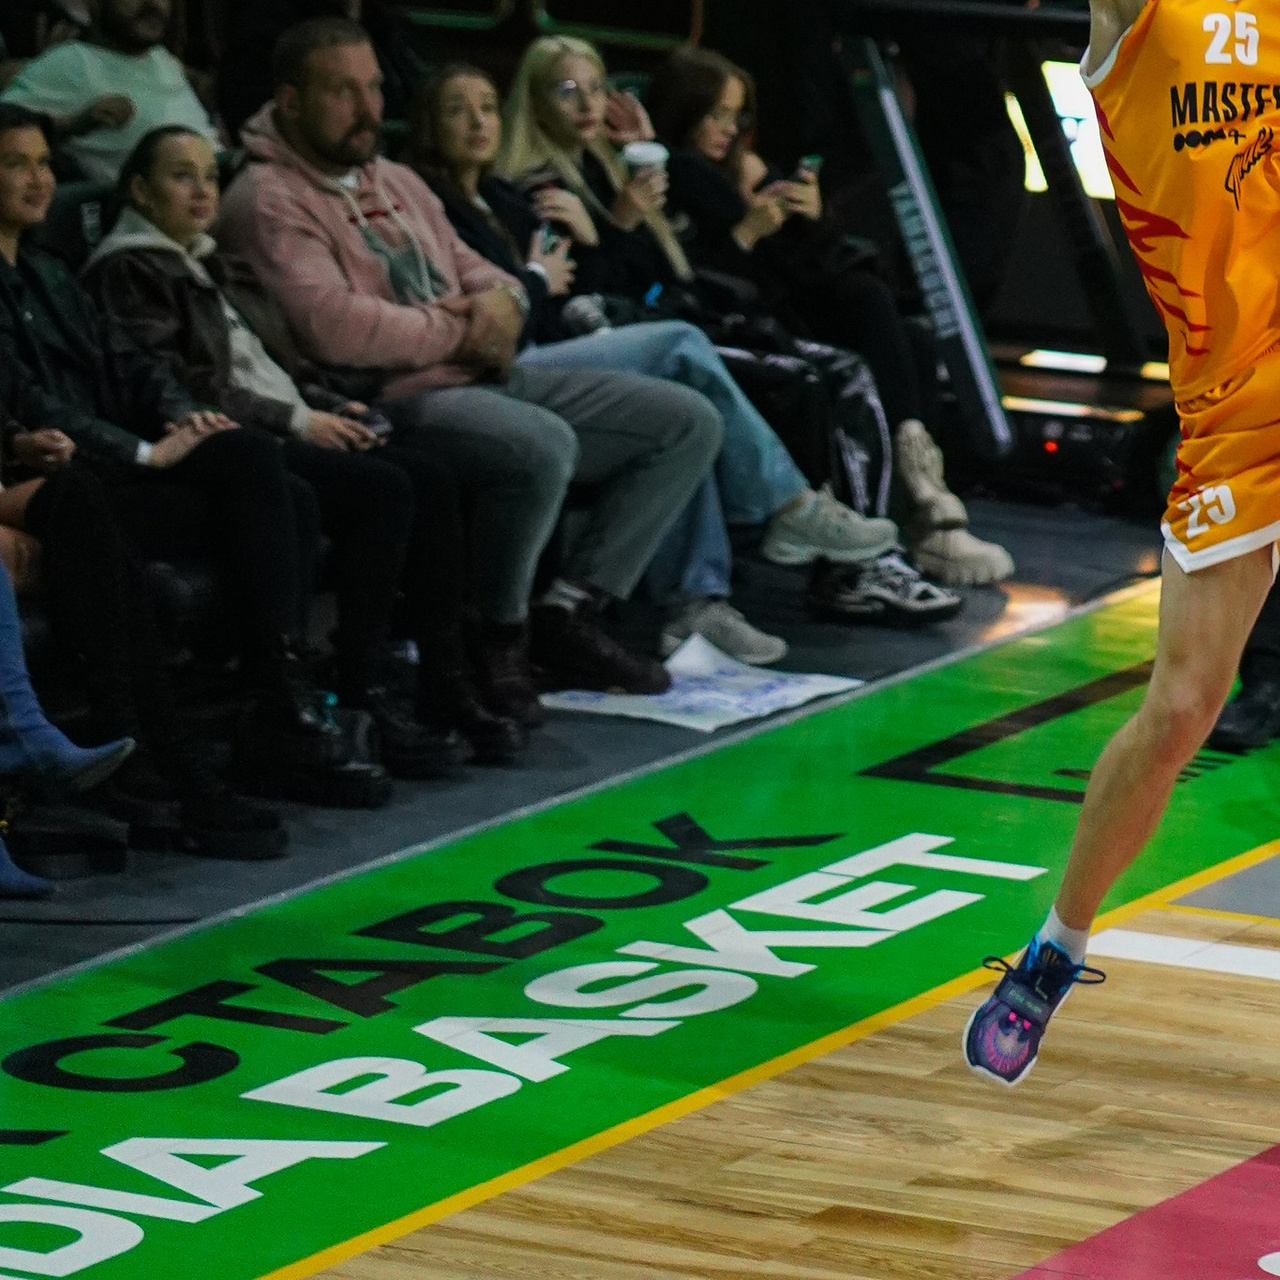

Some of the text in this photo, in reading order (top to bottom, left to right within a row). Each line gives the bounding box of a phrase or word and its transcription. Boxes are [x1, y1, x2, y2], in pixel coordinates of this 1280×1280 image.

[1202, 11, 1260, 66] 25
[1177, 485, 1237, 539] 25
[1, 812, 847, 1093] СТАВОК
[241, 832, 1049, 1128] BASKET
